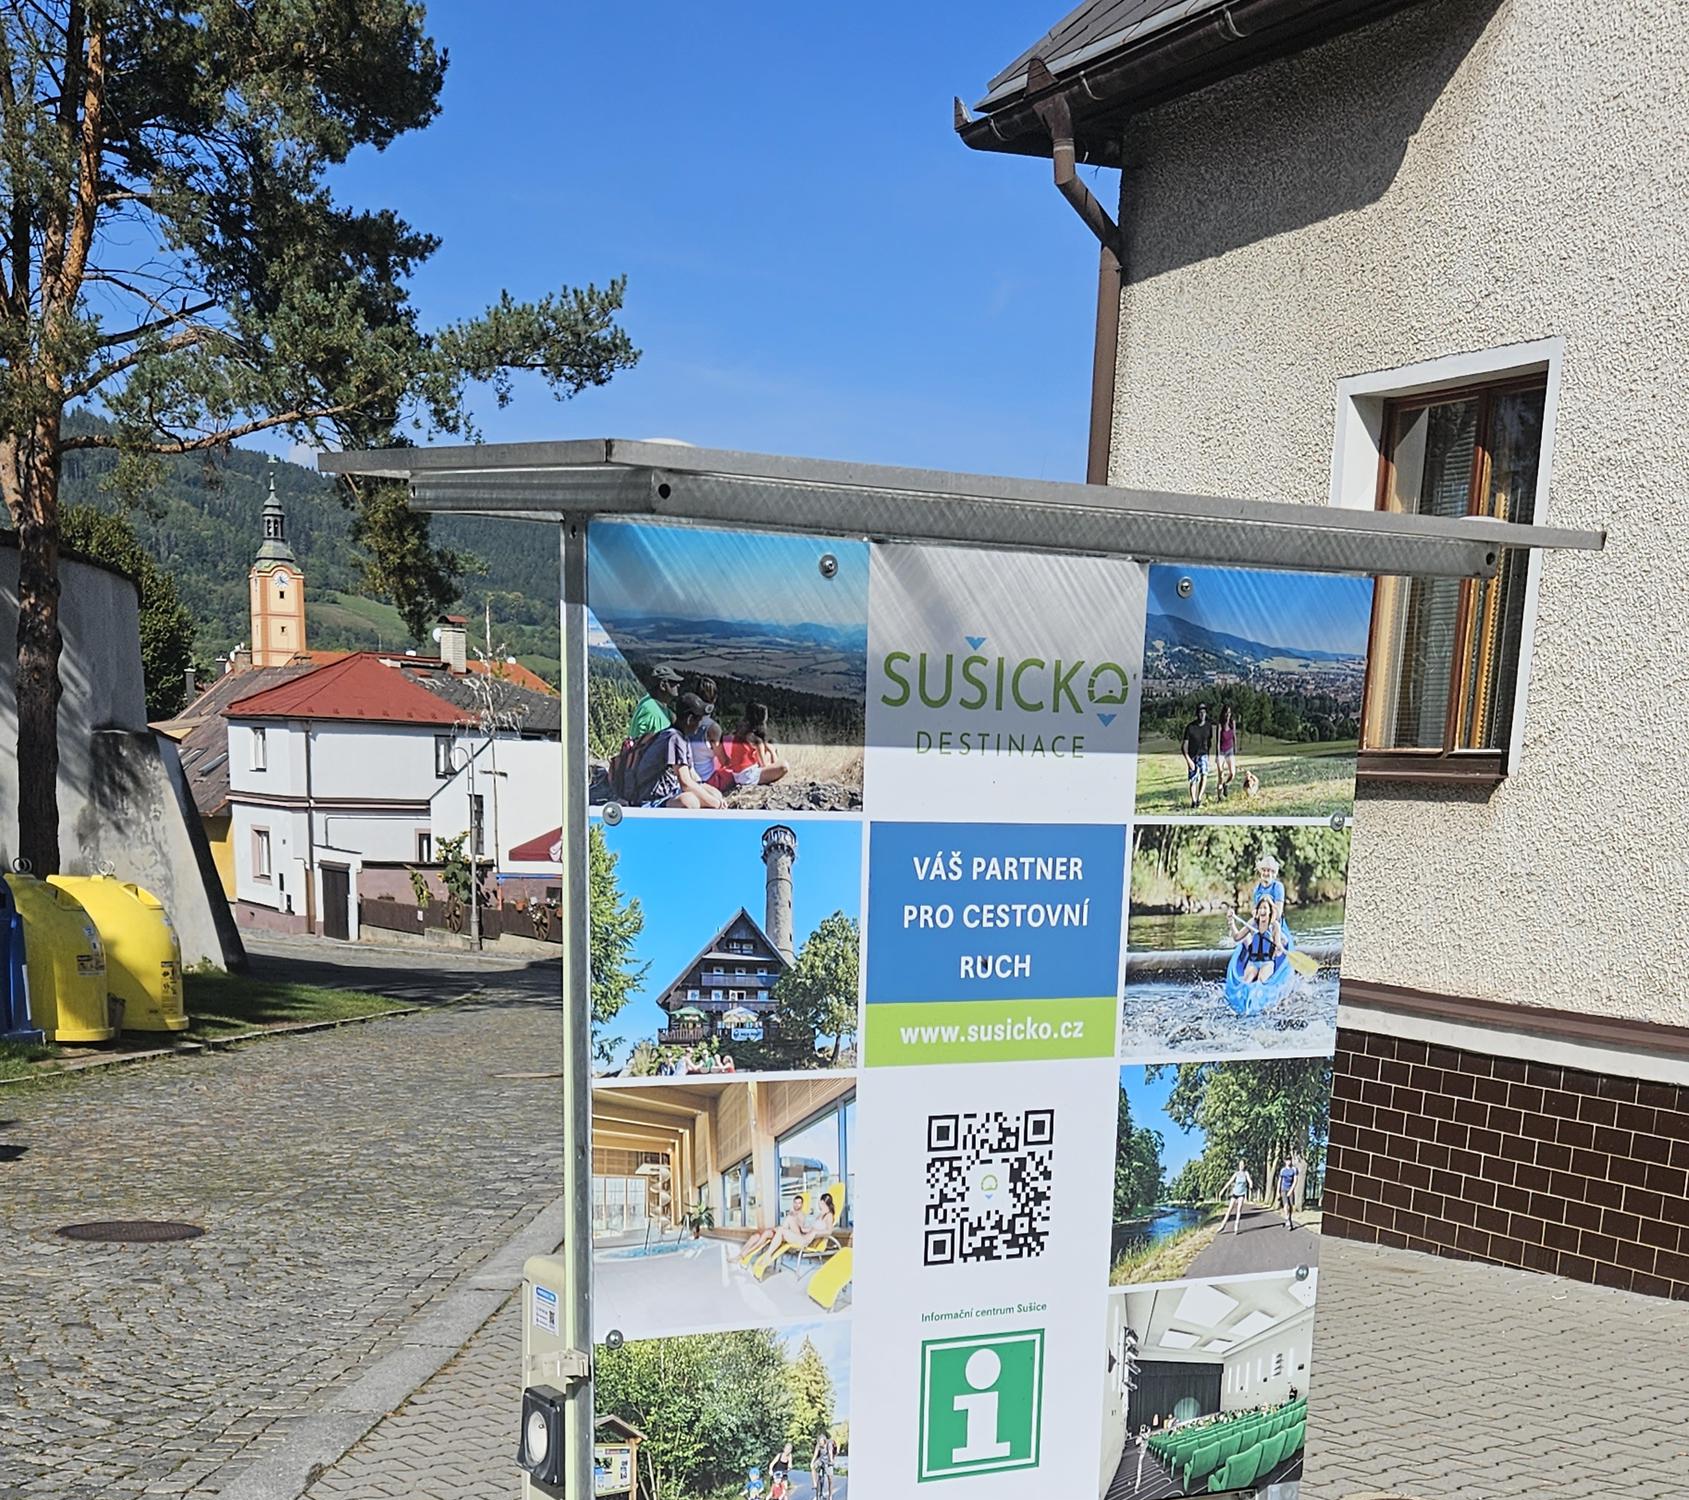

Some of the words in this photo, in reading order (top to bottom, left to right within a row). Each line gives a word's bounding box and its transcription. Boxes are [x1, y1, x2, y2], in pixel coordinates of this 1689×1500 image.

[881, 636, 1129, 714] SUŠICKO
[916, 730, 1086, 758] DESTINACE
[913, 850, 963, 881] VÁŠ
[972, 856, 1083, 881] PARTNER
[903, 904, 954, 928] PRO
[962, 897, 1090, 928] CESTOVNÍ
[959, 953, 1032, 979] RUCH
[900, 1016, 1085, 1044] www.susicko.cz
[921, 1307, 973, 1322] Informační
[975, 1305, 1014, 1318] centrum
[1016, 1301, 1047, 1313] Sušice
